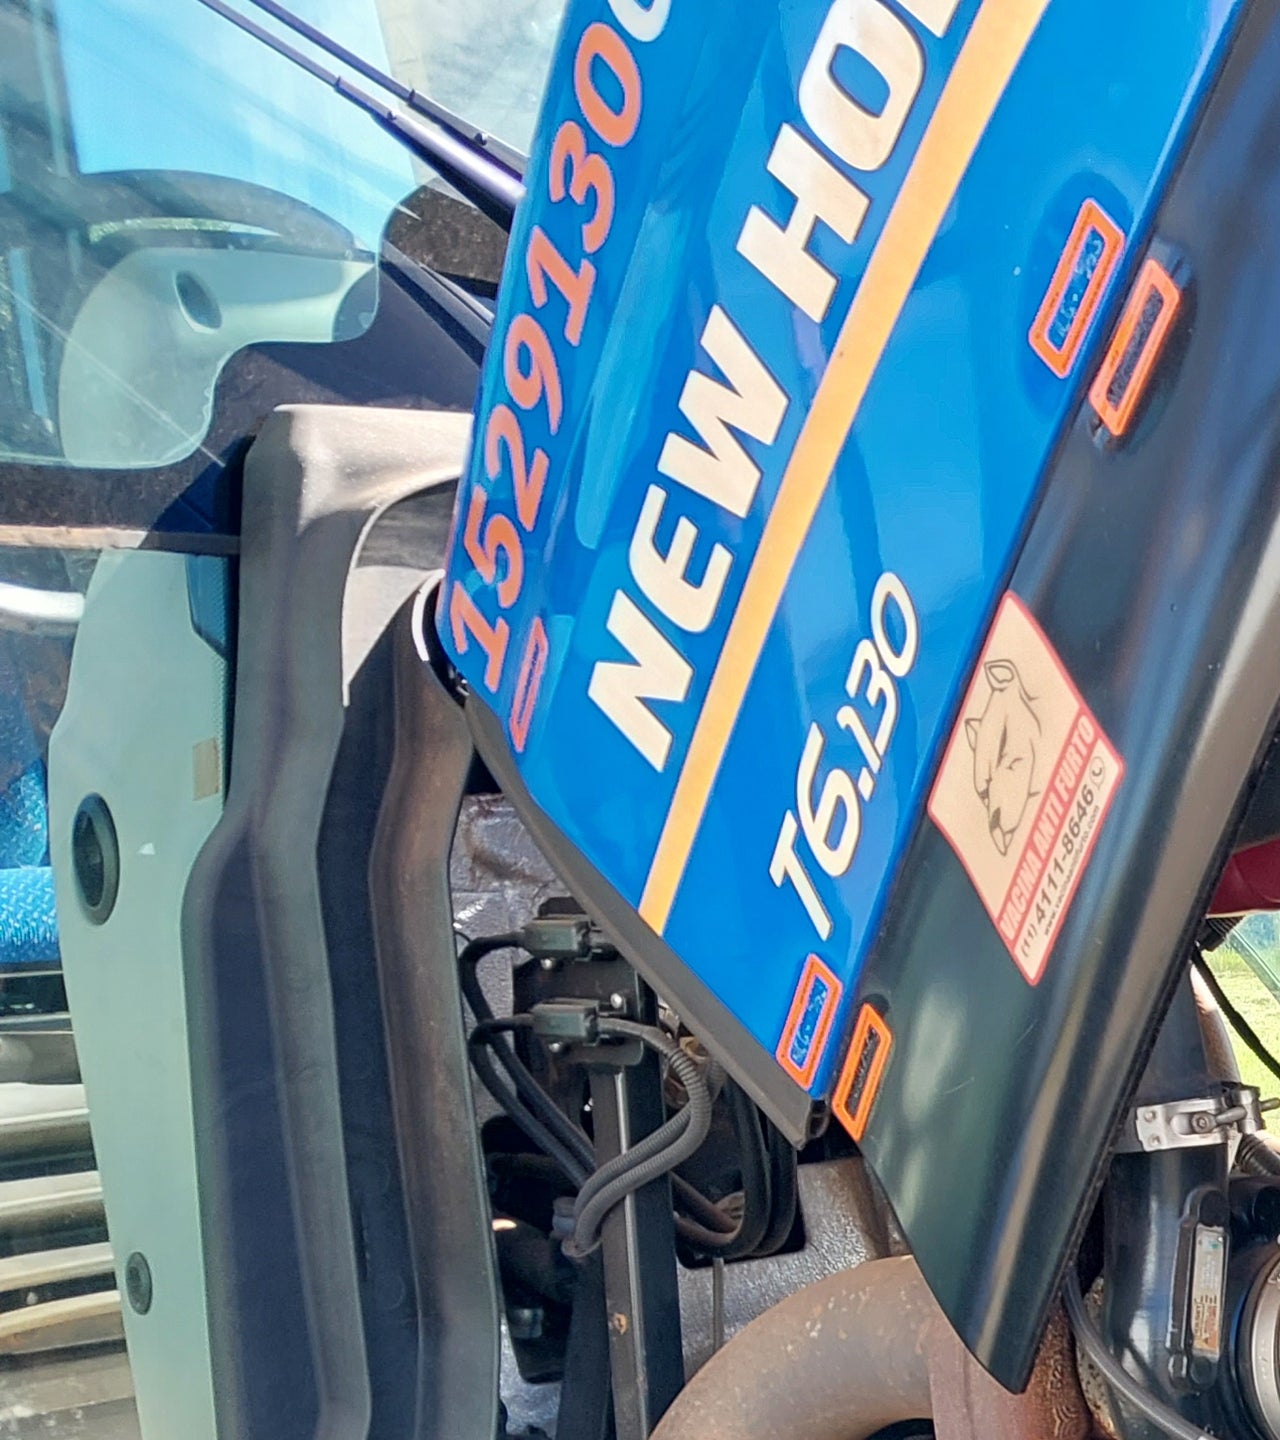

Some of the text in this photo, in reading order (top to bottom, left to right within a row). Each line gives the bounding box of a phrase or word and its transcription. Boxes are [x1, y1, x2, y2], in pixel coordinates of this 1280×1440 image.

[587, 0, 961, 774] NEW HO
[769, 571, 919, 943] T6.130
[1000, 715, 1096, 941] VACINA ANTI FURTO
[1021, 784, 1095, 957] (11) 4111-8646
